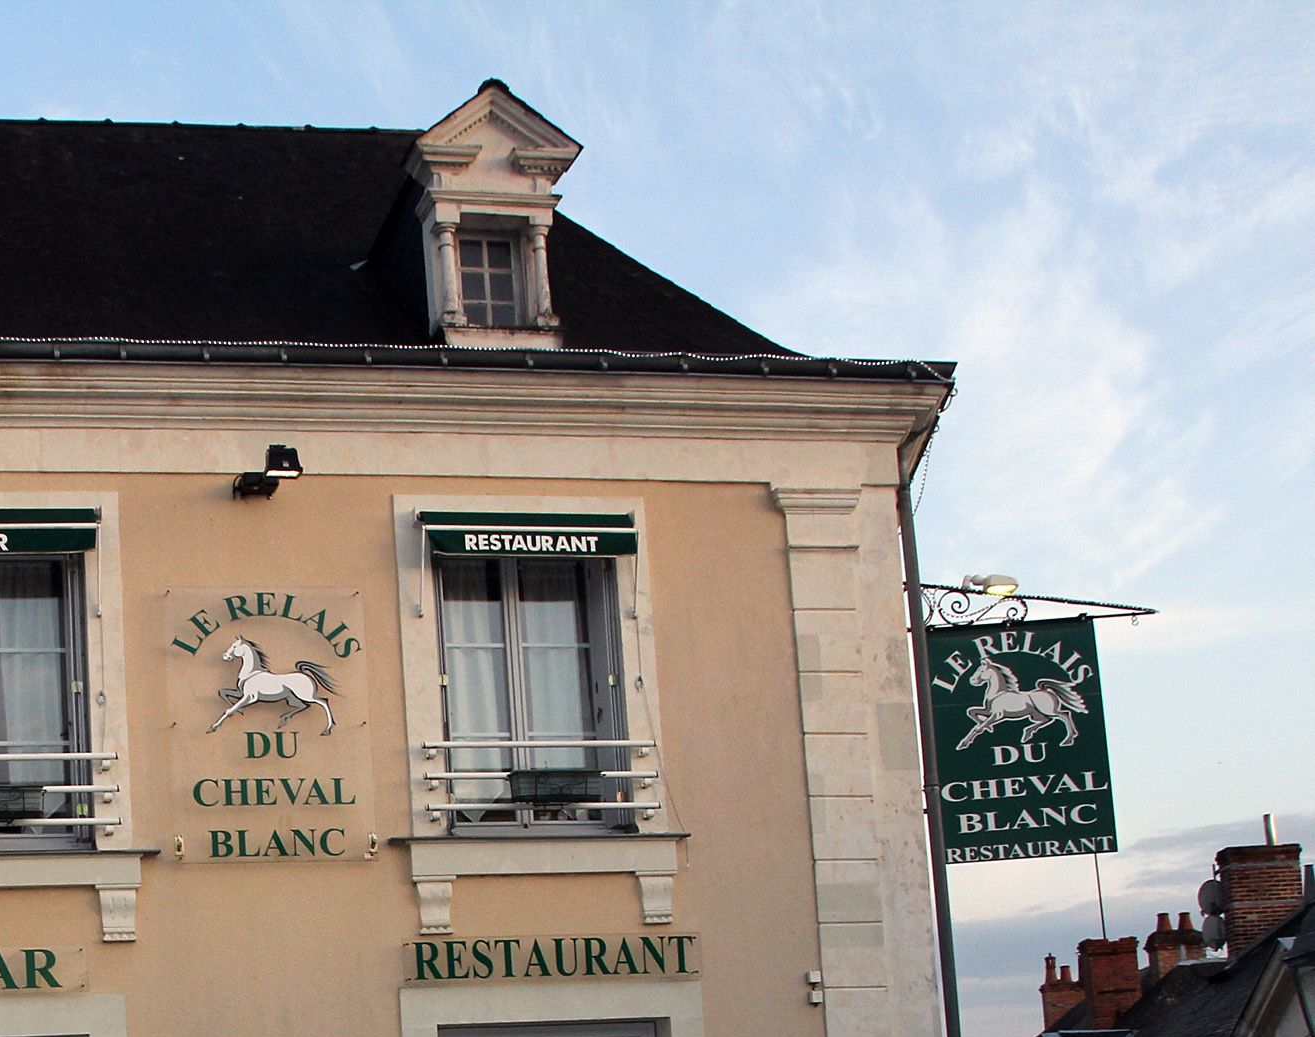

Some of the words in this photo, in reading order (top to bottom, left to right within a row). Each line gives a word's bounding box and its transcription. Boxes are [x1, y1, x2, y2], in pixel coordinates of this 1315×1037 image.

[464, 534, 598, 552] RESTAURANT
[170, 609, 221, 656] LE
[222, 591, 362, 659] RELAIS
[932, 650, 974, 694] LE
[972, 631, 1094, 684] RELAIS
[244, 731, 299, 759] DU
[992, 742, 1047, 766] DU
[192, 777, 355, 807] CHEVAL
[941, 771, 1109, 802] CHEVAL
[957, 804, 1098, 835] BLANC
[207, 828, 346, 858] BLANC
[947, 835, 1114, 863] RESTAURANT
[412, 936, 694, 980] RESTAURANT
